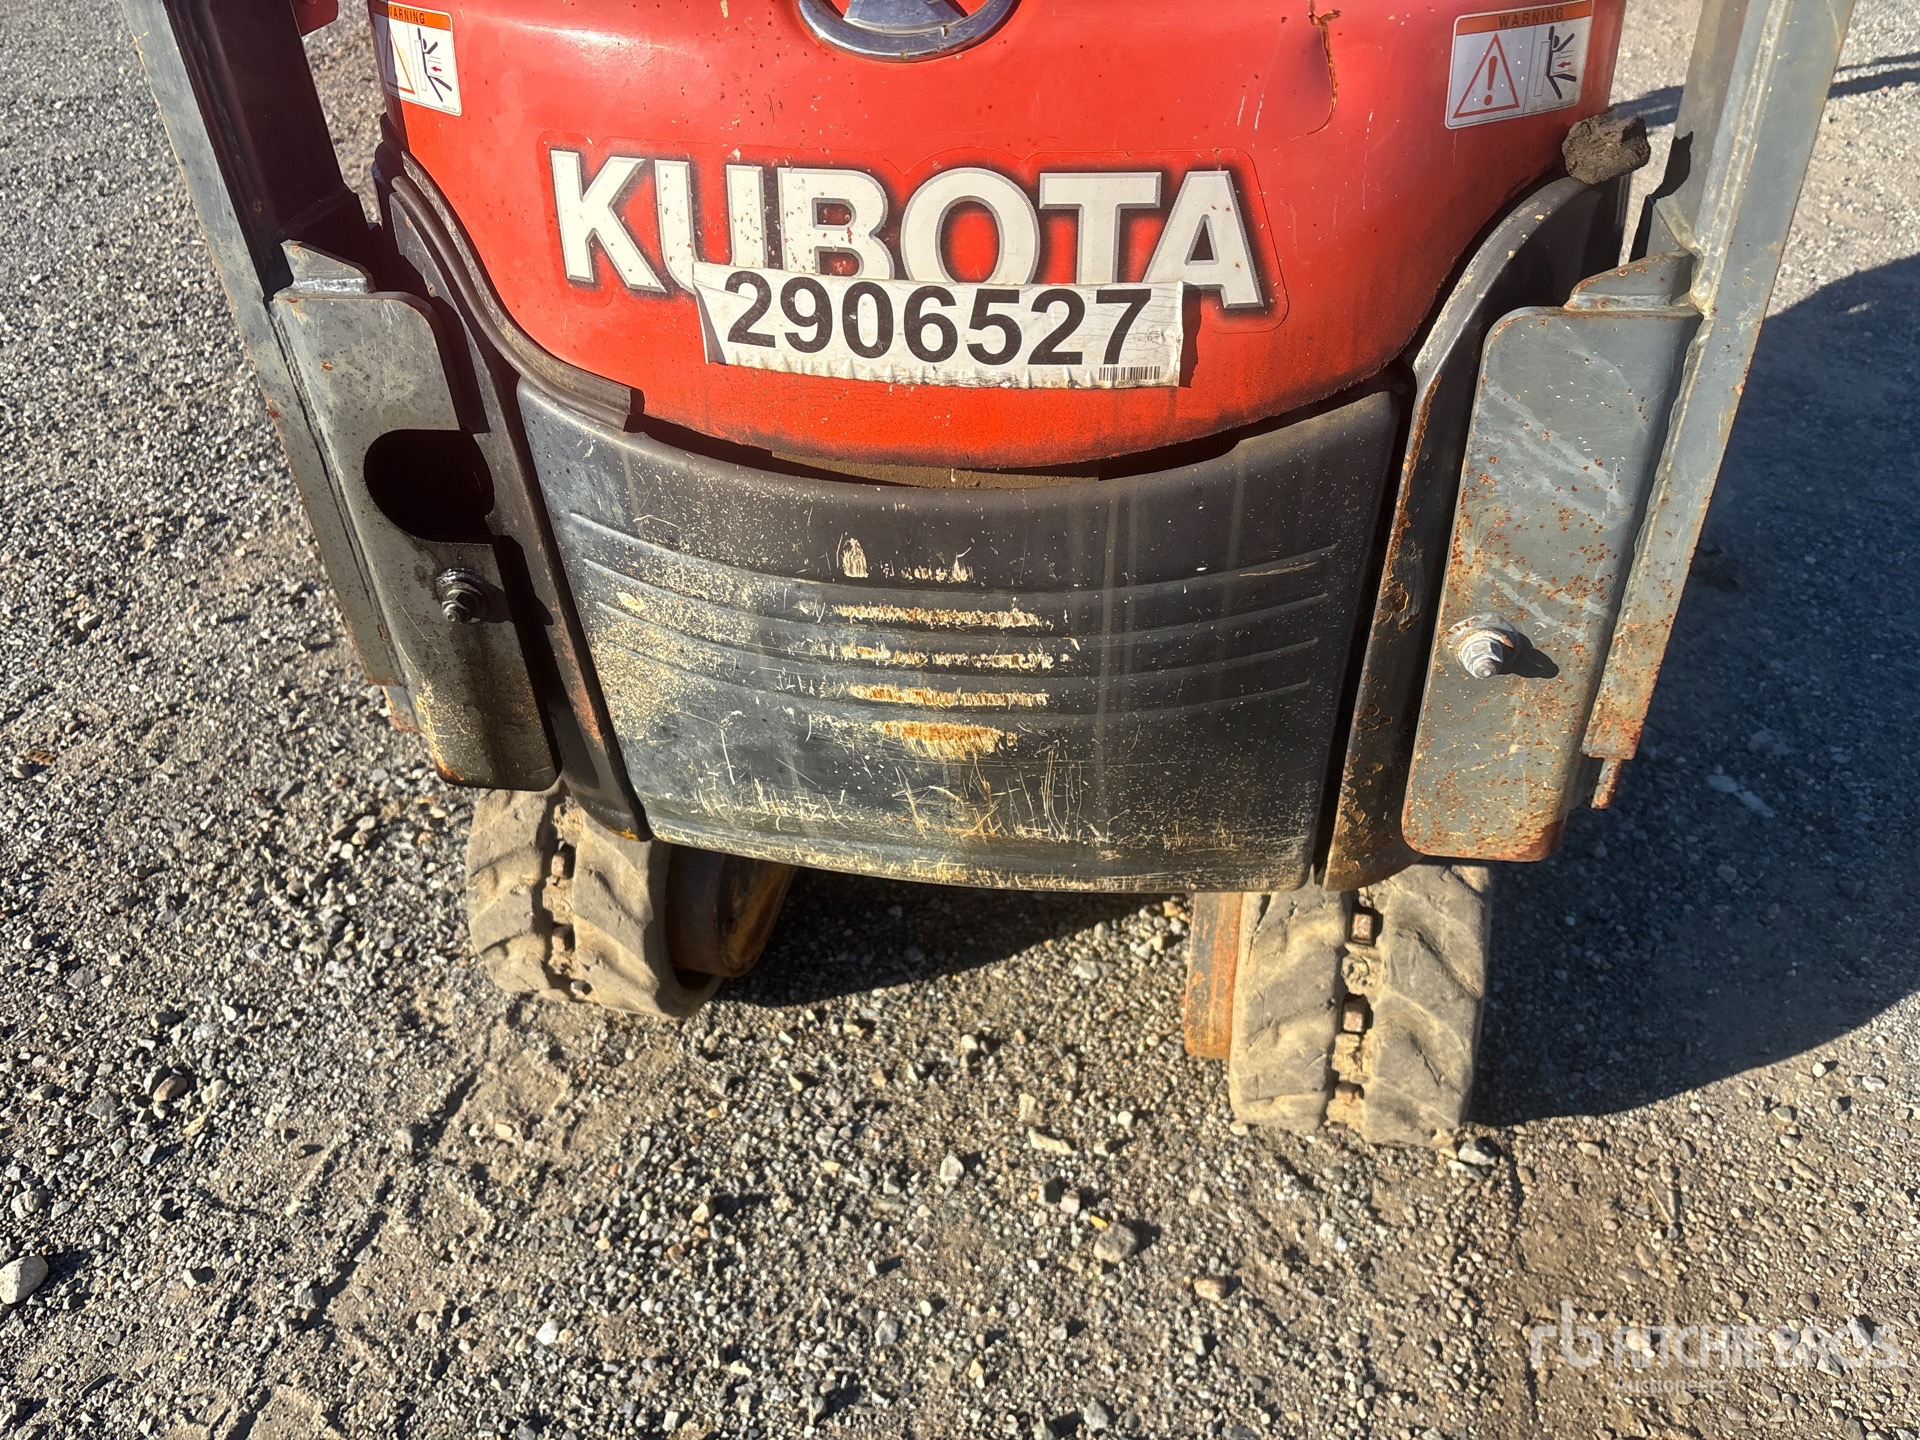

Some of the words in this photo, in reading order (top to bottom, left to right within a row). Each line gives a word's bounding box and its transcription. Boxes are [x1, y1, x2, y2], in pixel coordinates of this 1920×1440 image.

[1499, 8, 1564, 28] WARNING
[549, 148, 1268, 309] KUBOTA
[723, 270, 1152, 366] 2906527
